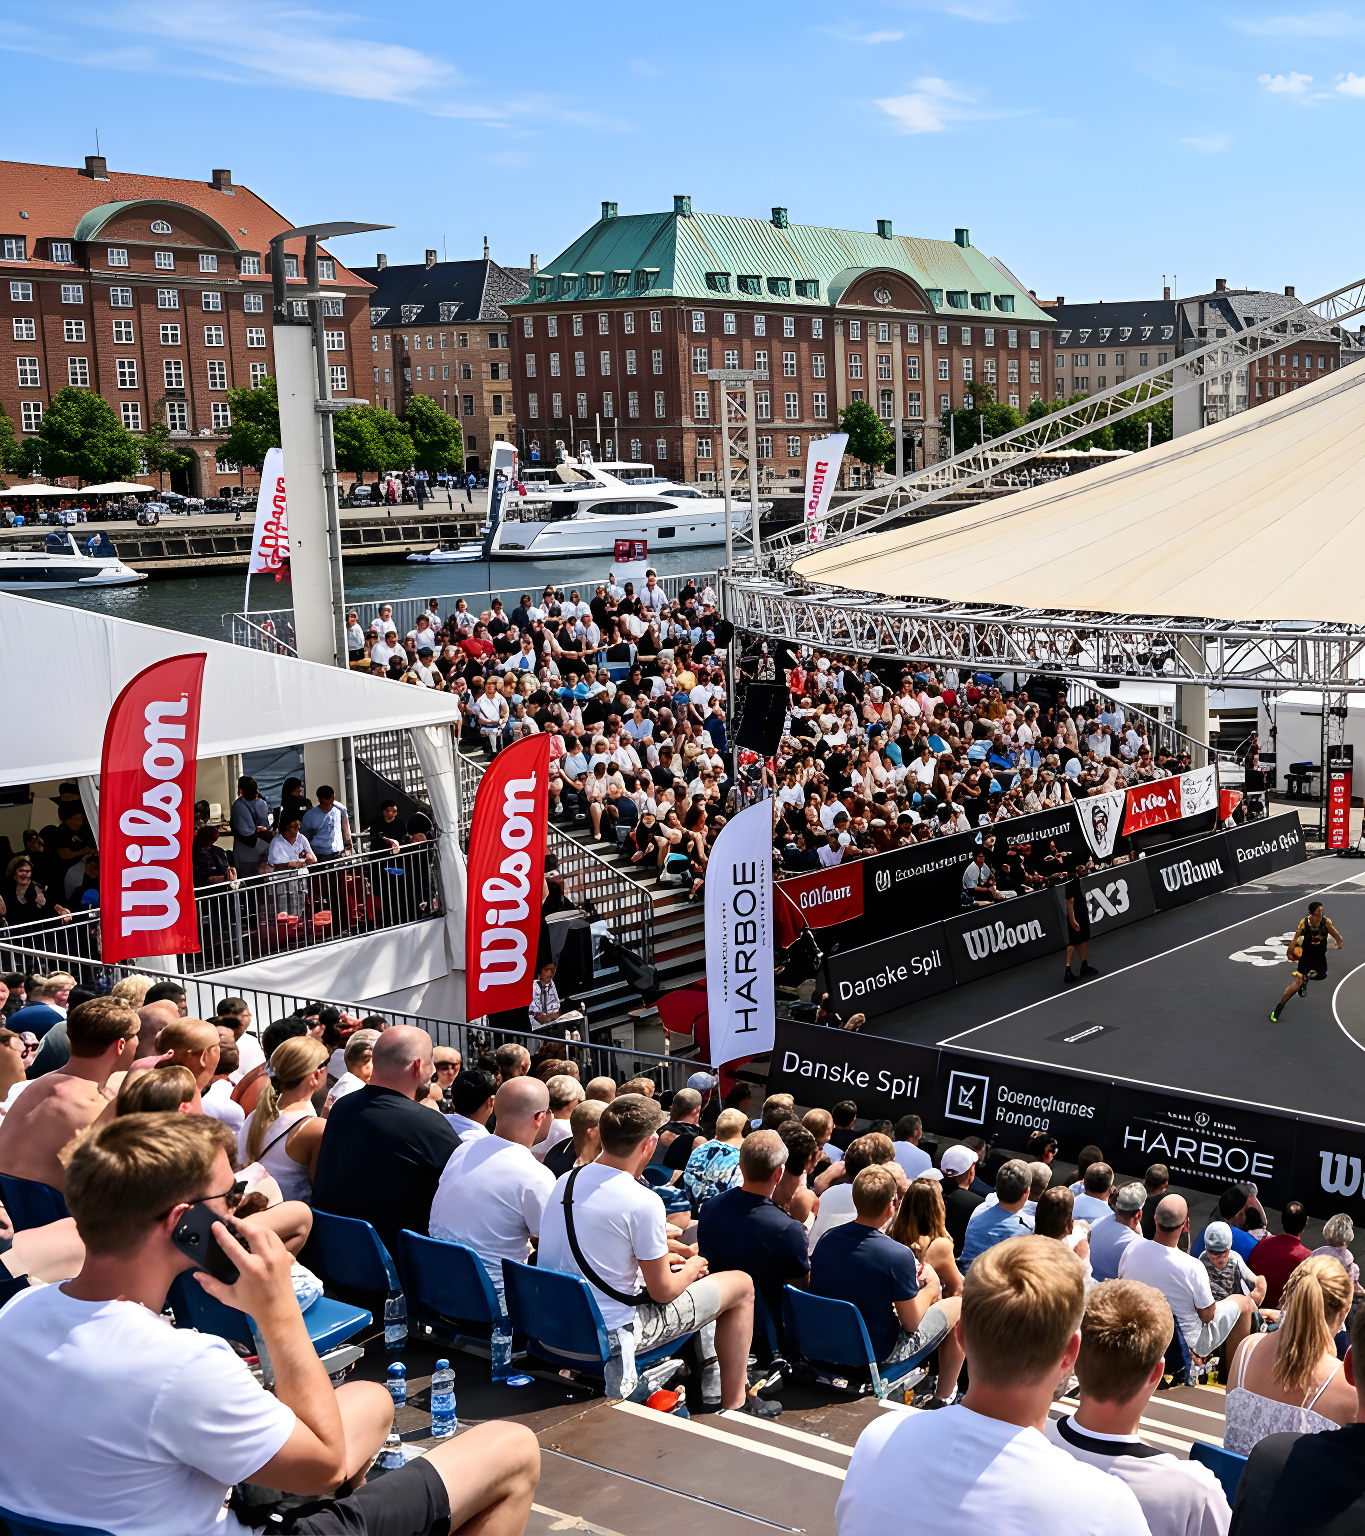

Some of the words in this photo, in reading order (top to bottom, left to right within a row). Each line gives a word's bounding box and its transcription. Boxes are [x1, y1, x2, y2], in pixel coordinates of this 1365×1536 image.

[479, 770, 537, 992] Wilson
[733, 861, 758, 1034] HARBOE
[782, 1051, 870, 1088] Danske
[876, 1070, 920, 1100] Spil
[1123, 1125, 1275, 1179] HARBOE
